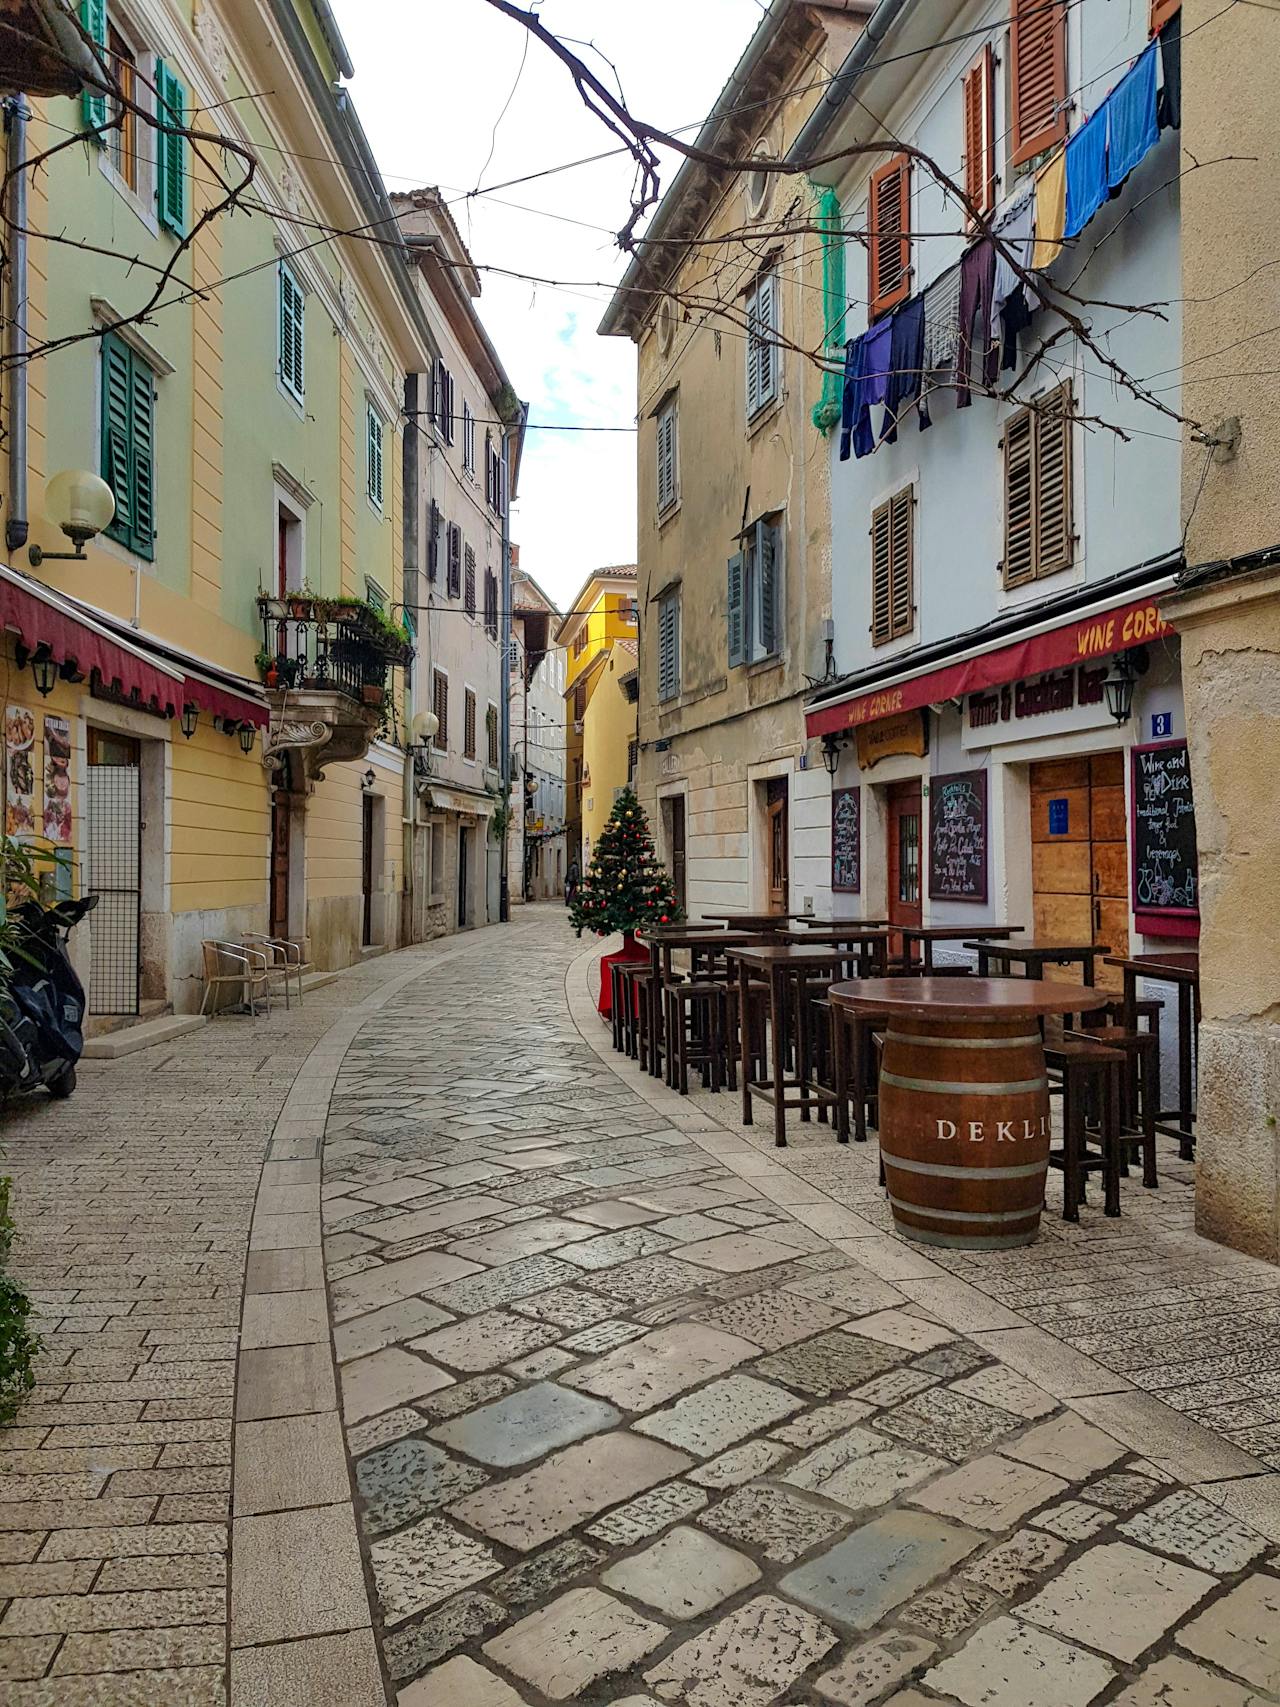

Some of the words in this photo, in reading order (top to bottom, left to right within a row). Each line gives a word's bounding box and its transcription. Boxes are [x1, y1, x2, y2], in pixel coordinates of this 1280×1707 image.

[1078, 619, 1116, 656] WINE
[1122, 606, 1175, 643] CORN
[848, 700, 868, 723] WINE
[869, 689, 904, 717] CORNER
[1157, 715, 1165, 734] 3
[1140, 752, 1164, 774] Wine
[1166, 749, 1186, 770] and
[1160, 771, 1189, 793] Dine
[936, 1115, 1051, 1141] DEKLI
